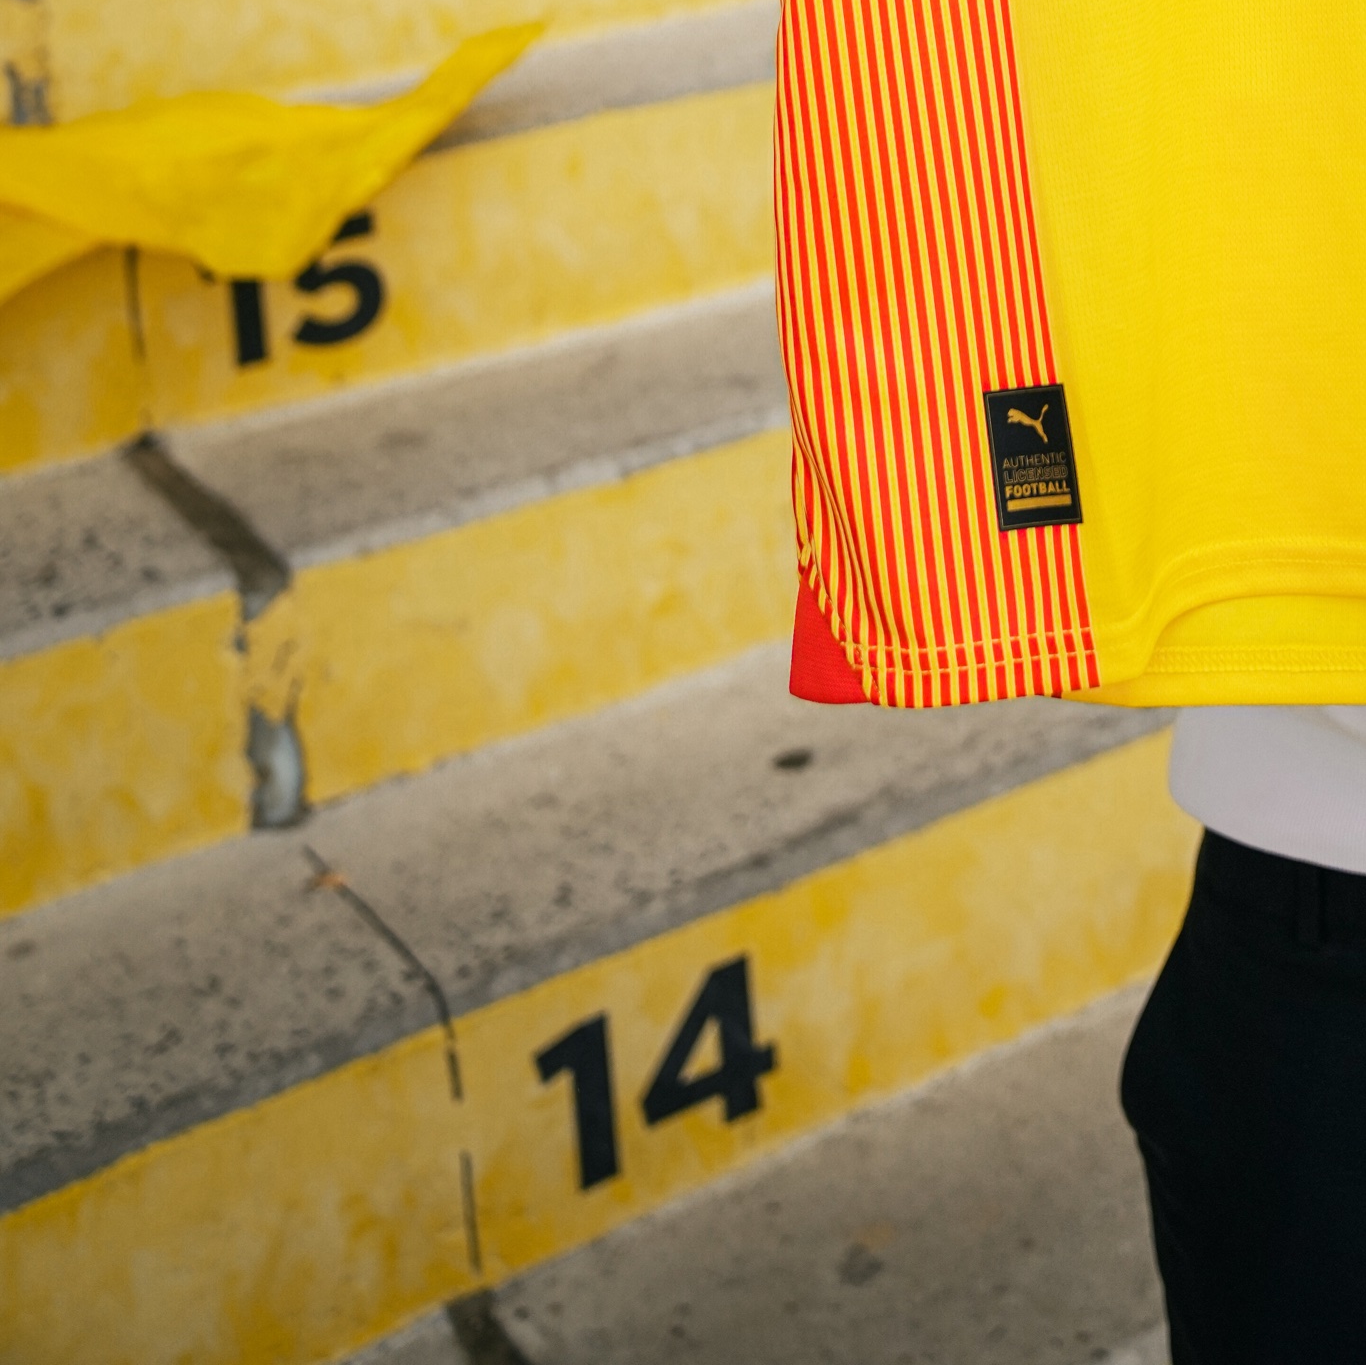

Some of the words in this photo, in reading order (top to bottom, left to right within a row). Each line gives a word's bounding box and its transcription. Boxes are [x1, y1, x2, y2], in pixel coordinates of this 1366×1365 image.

[1003, 451, 1067, 469] AUTHENTIC
[1003, 465, 1069, 484] LICENSED
[1005, 480, 1070, 499] FOOTBALL
[534, 953, 780, 1193] 14
